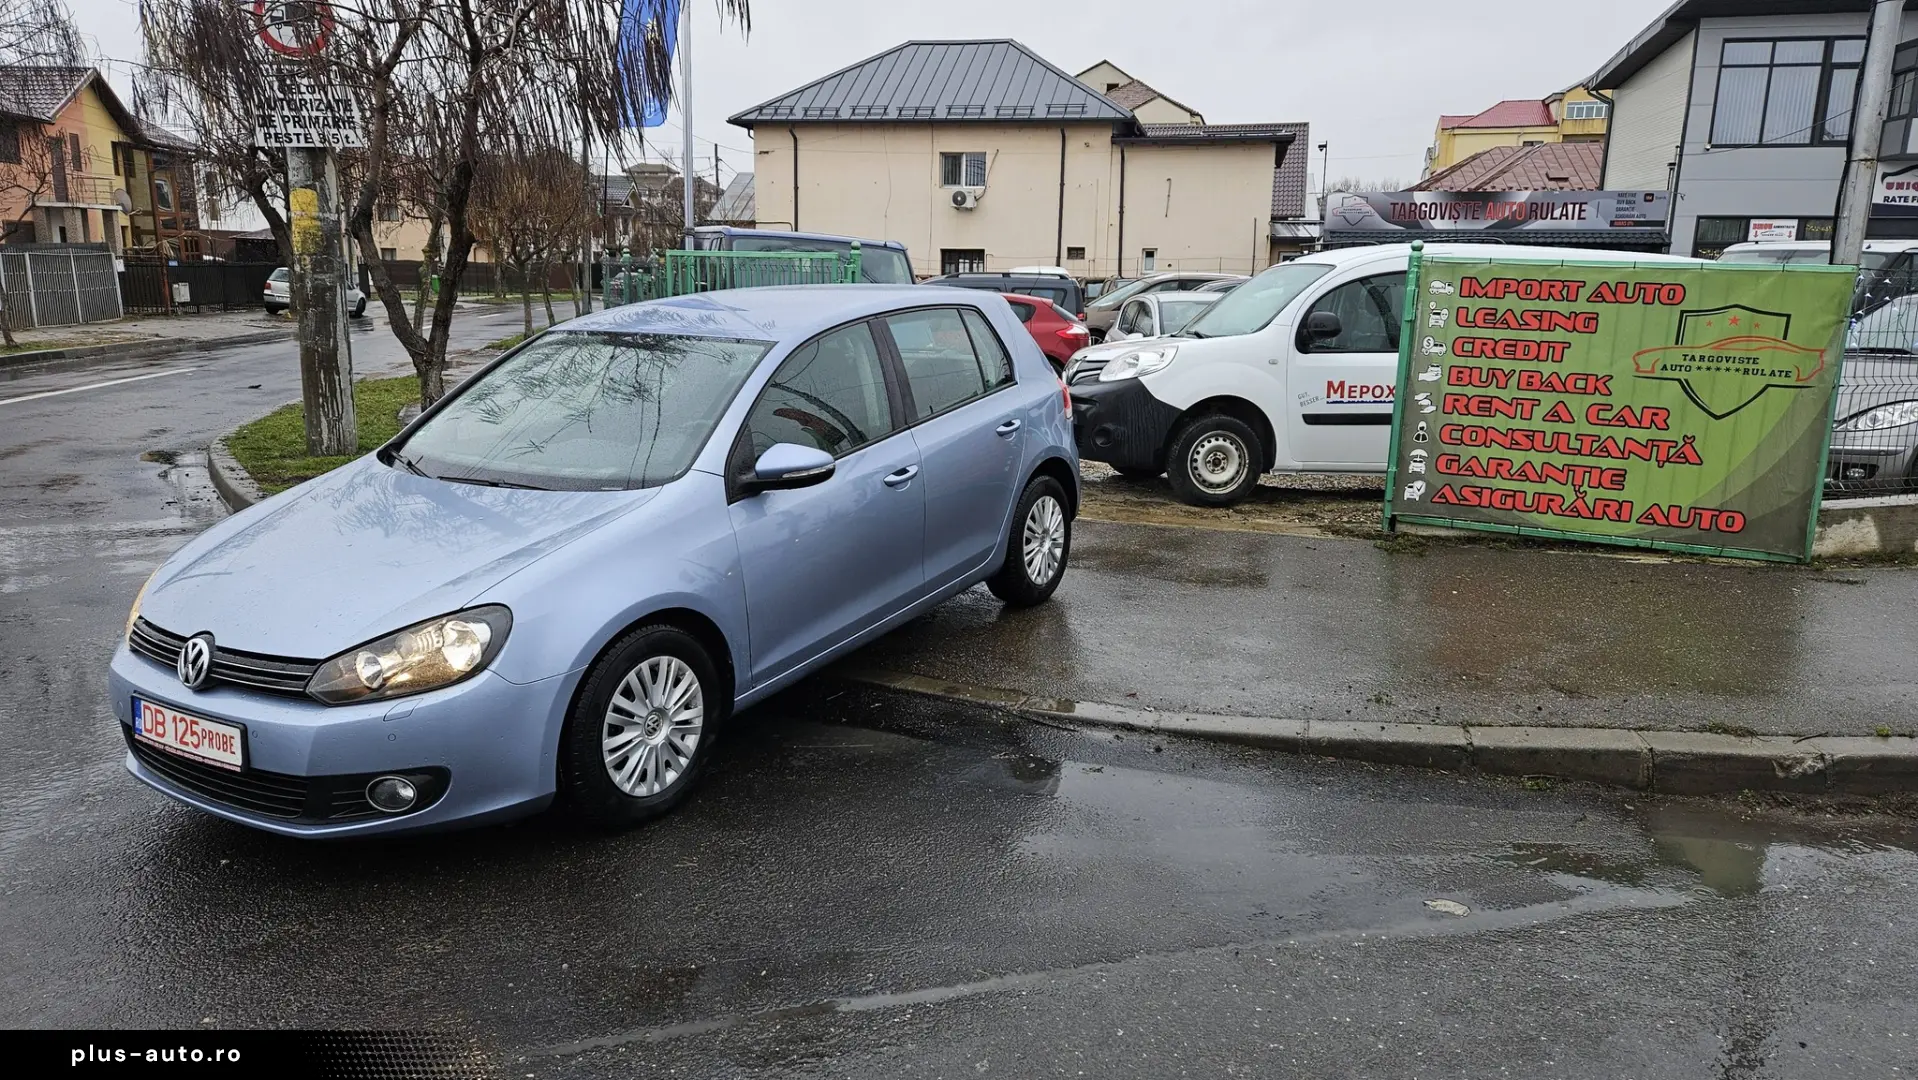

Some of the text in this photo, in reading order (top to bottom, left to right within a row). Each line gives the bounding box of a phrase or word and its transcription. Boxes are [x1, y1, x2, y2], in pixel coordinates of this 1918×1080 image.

[258, 115, 277, 128] DE
[264, 133, 313, 144] PESTE
[1390, 202, 1589, 221] TARGOVISTE AUTO RULATE
[1883, 195, 1910, 203] RATE
[1459, 277, 1686, 305] IMPORT AUTO
[1456, 307, 1599, 333] LEASING
[1452, 336, 1571, 362] CREDIT
[1681, 353, 1760, 365] TARGOVISTE
[1447, 365, 1613, 396] BUY BACK
[1660, 364, 1792, 379] AUTO RULATE
[1442, 394, 1671, 430] RENT A CAR
[1439, 424, 1703, 467] CONSULTANȚĂ
[1430, 484, 1747, 534] ASIGURĂRI AUTO
[142, 703, 166, 739] DB
[171, 715, 201, 750] 125
[201, 729, 236, 755] PROBE
